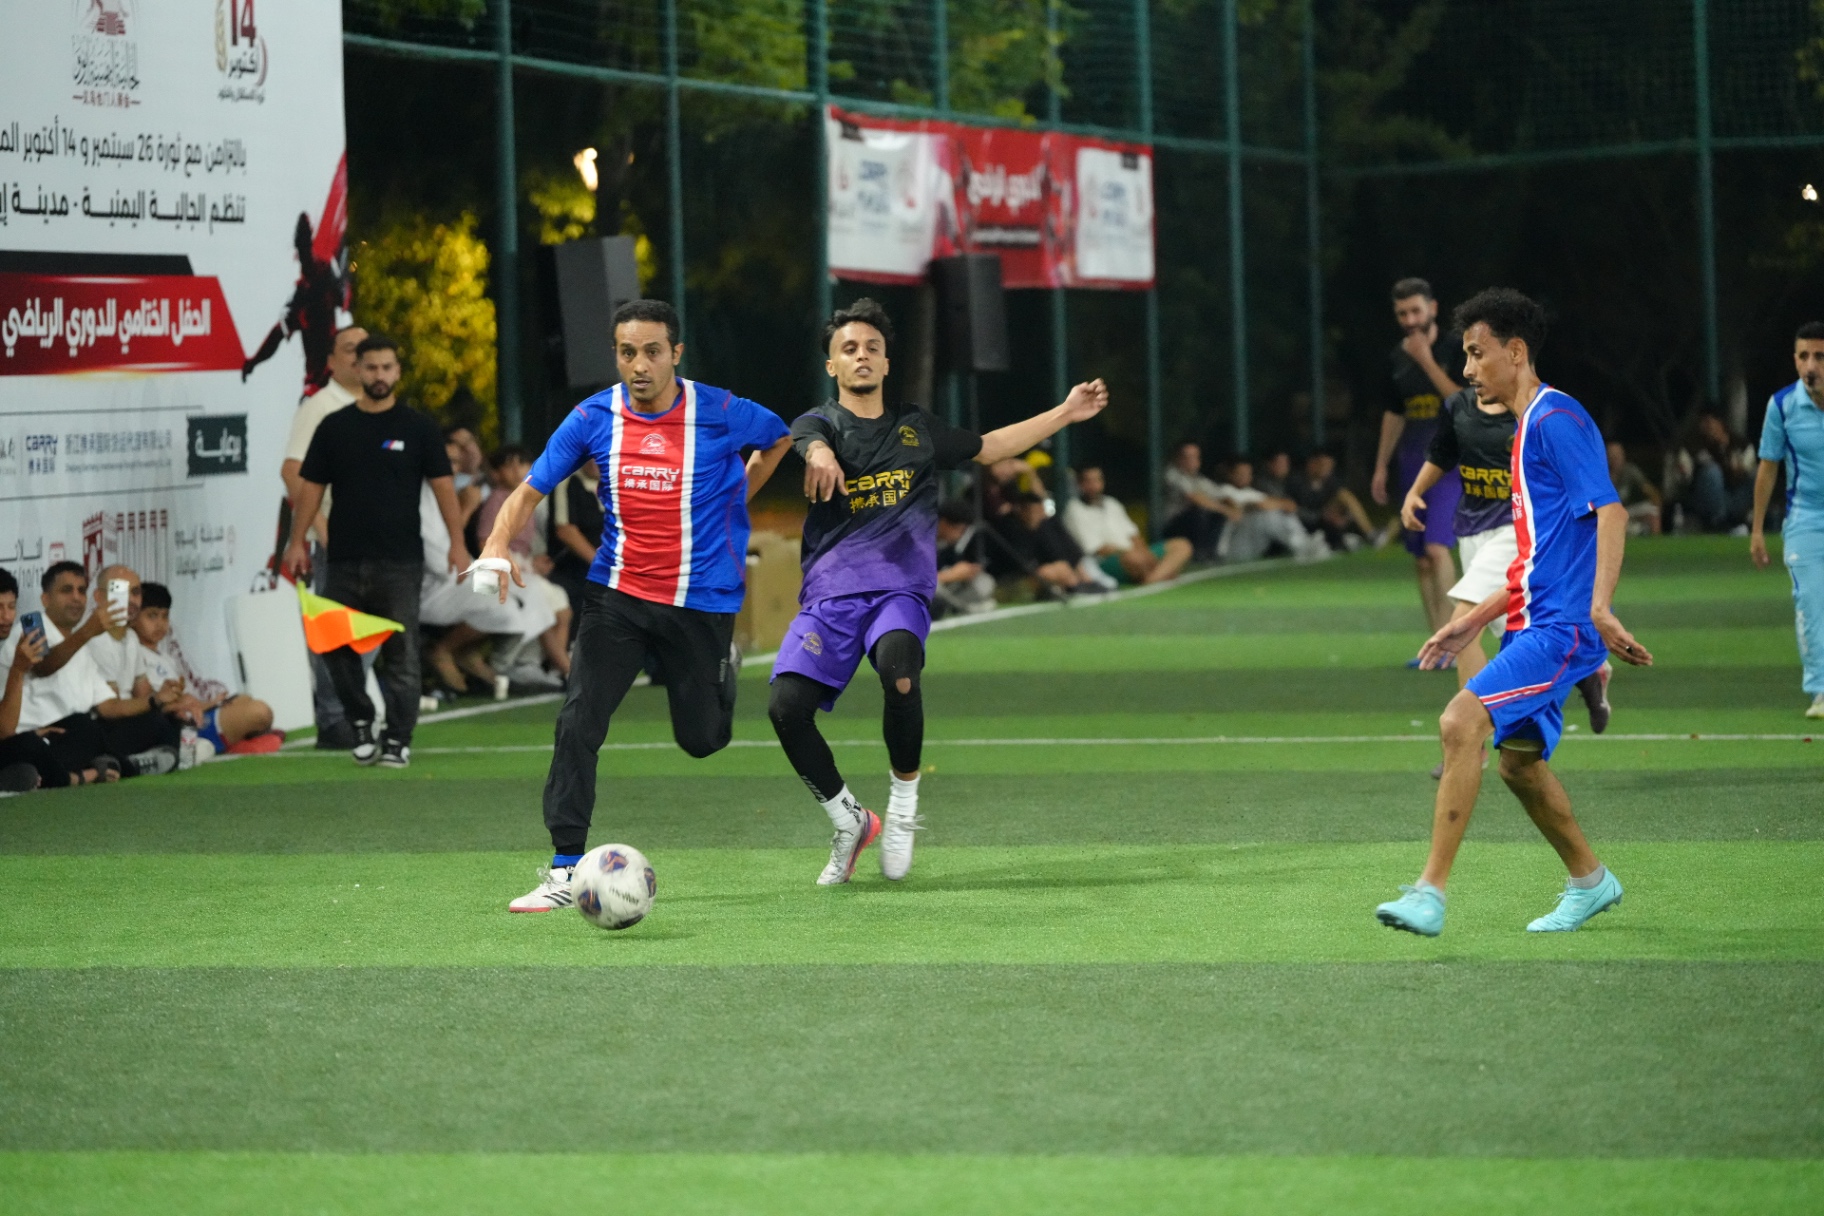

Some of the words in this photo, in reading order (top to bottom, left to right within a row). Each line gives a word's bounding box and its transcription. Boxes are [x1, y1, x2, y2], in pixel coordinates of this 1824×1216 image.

[23, 115, 59, 163] أكتوبر
[62, 127, 76, 157] 14
[80, 136, 89, 166] و
[91, 132, 134, 168] سبتمبر
[138, 133, 153, 162] 26
[157, 131, 181, 171] ثورة
[185, 143, 201, 177] مع
[12, 182, 69, 225] مدينة
[82, 187, 146, 228] اليمنية
[150, 189, 206, 230] الجالية
[210, 192, 246, 234] تنظم
[2, 297, 64, 358] الرياضي
[65, 298, 117, 358] للدوري
[118, 298, 170, 355] الختامي
[171, 298, 212, 346] الحفل
